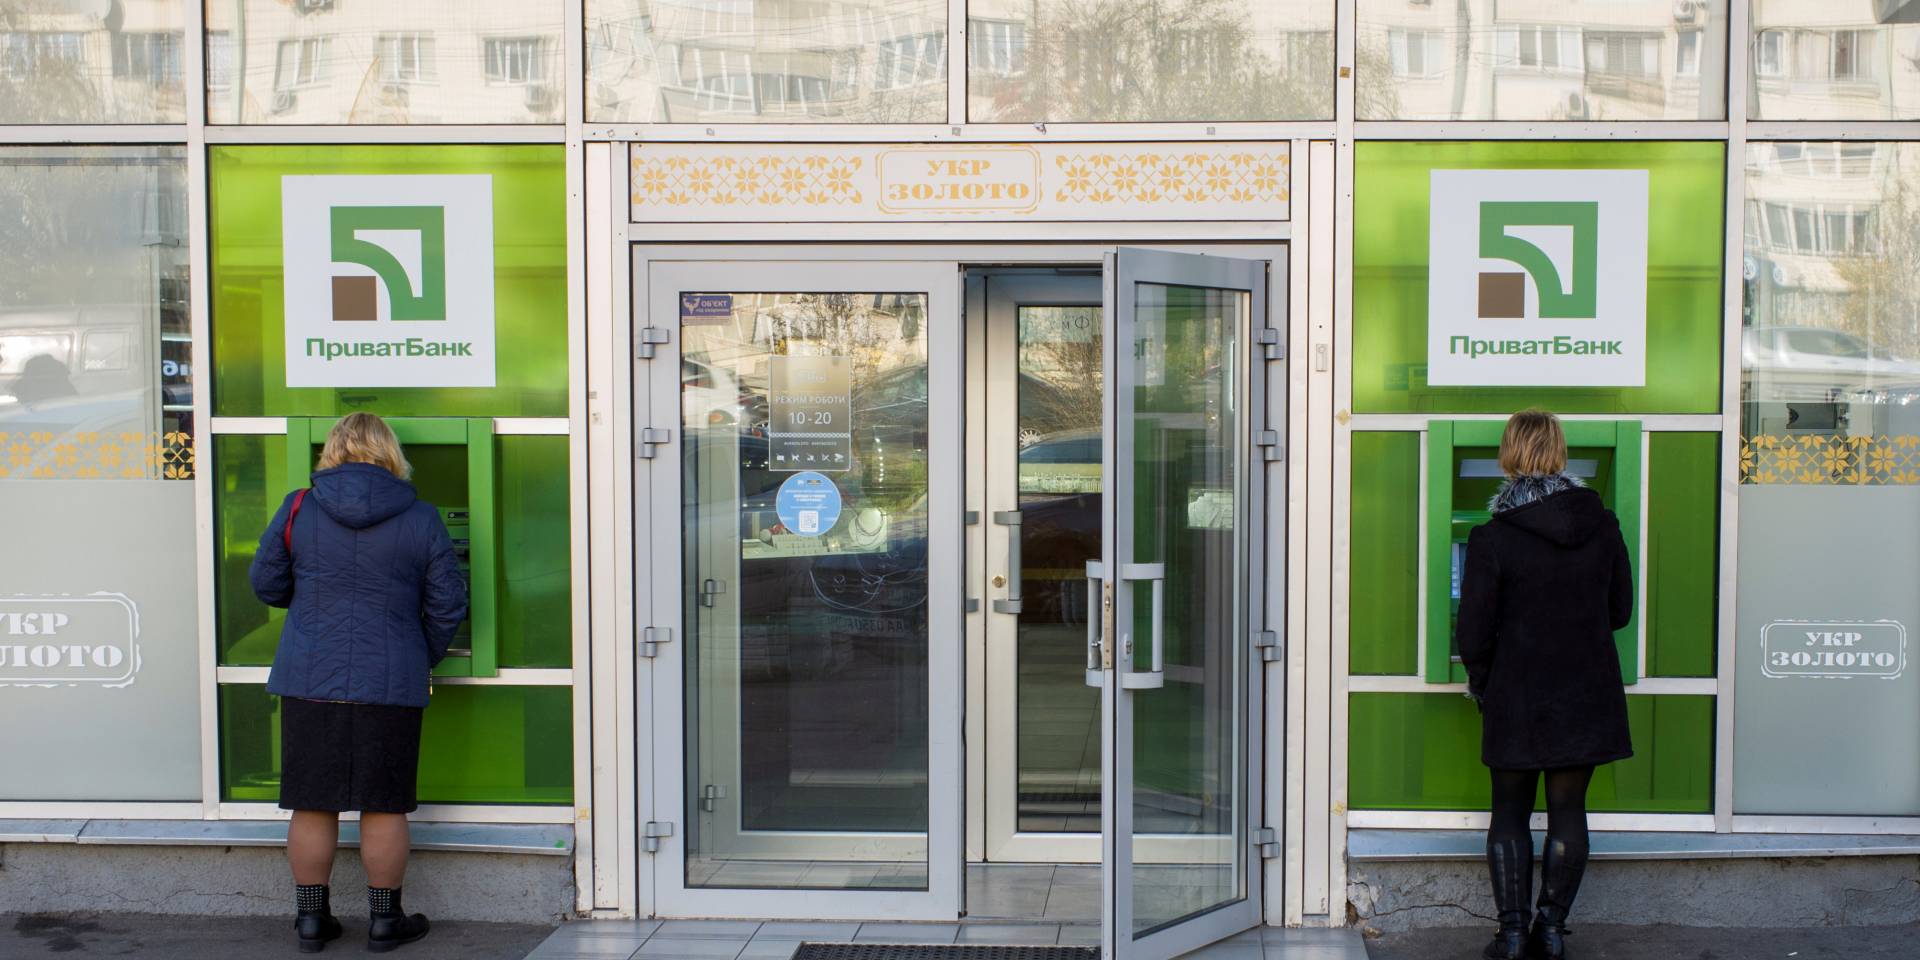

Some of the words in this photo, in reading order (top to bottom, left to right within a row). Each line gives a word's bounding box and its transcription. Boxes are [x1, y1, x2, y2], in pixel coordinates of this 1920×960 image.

[927, 159, 992, 177] УКР
[888, 183, 1030, 201] ЗОЛОТО
[306, 337, 473, 361] ПриватБанк
[1449, 335, 1623, 360] ПриватБанк
[0, 612, 69, 636] КР
[1805, 631, 1862, 647] УКР
[0, 645, 123, 668] ЛОТО
[1771, 651, 1896, 667] ЗОЛОТО
